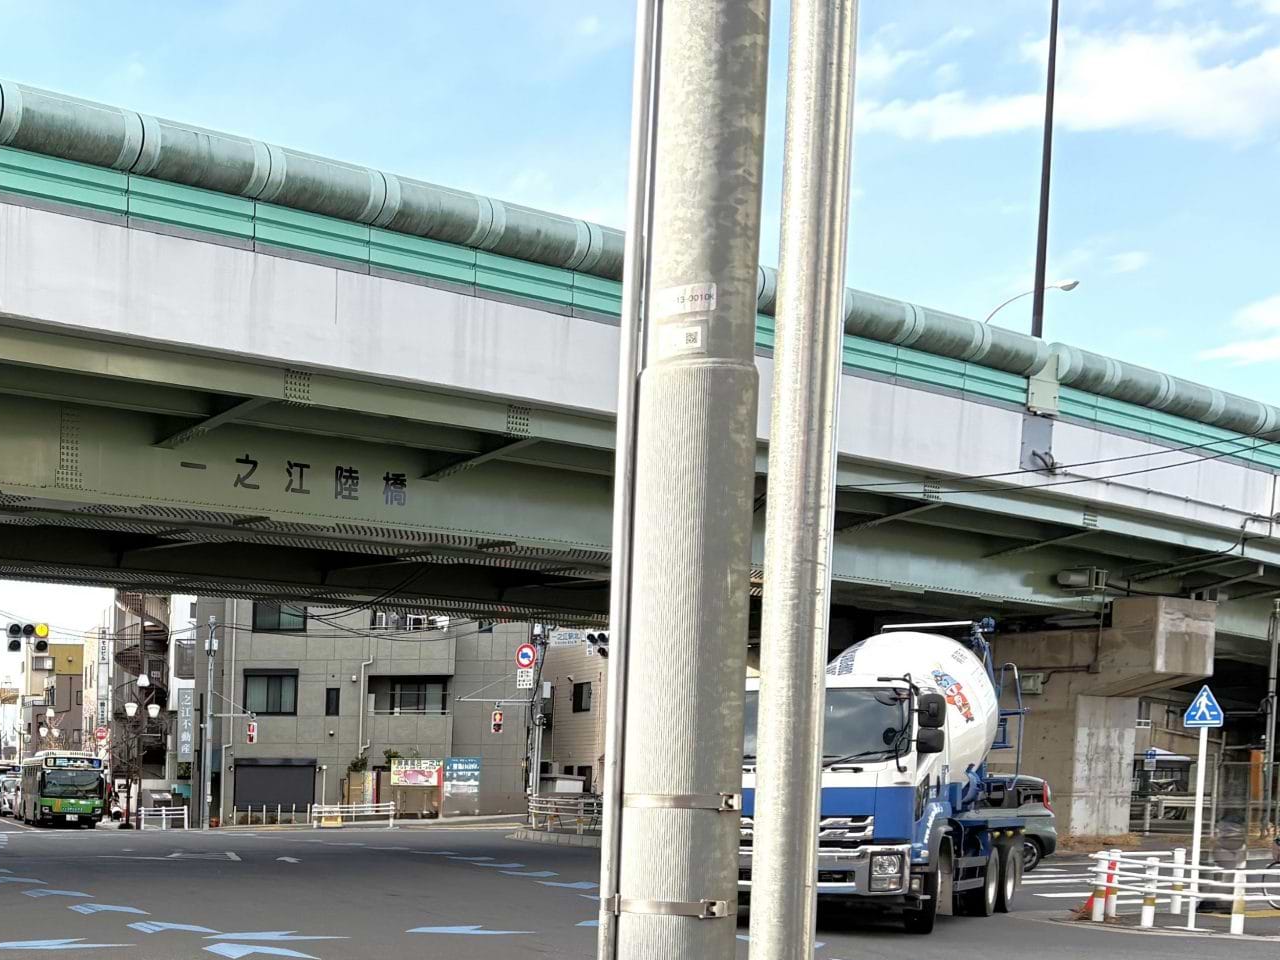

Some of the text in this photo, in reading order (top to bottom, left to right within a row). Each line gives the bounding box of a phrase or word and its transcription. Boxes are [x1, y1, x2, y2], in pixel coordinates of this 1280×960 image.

[180, 453, 407, 506] 一之江陸橋
[180, 690, 192, 753] 一之江不動産
